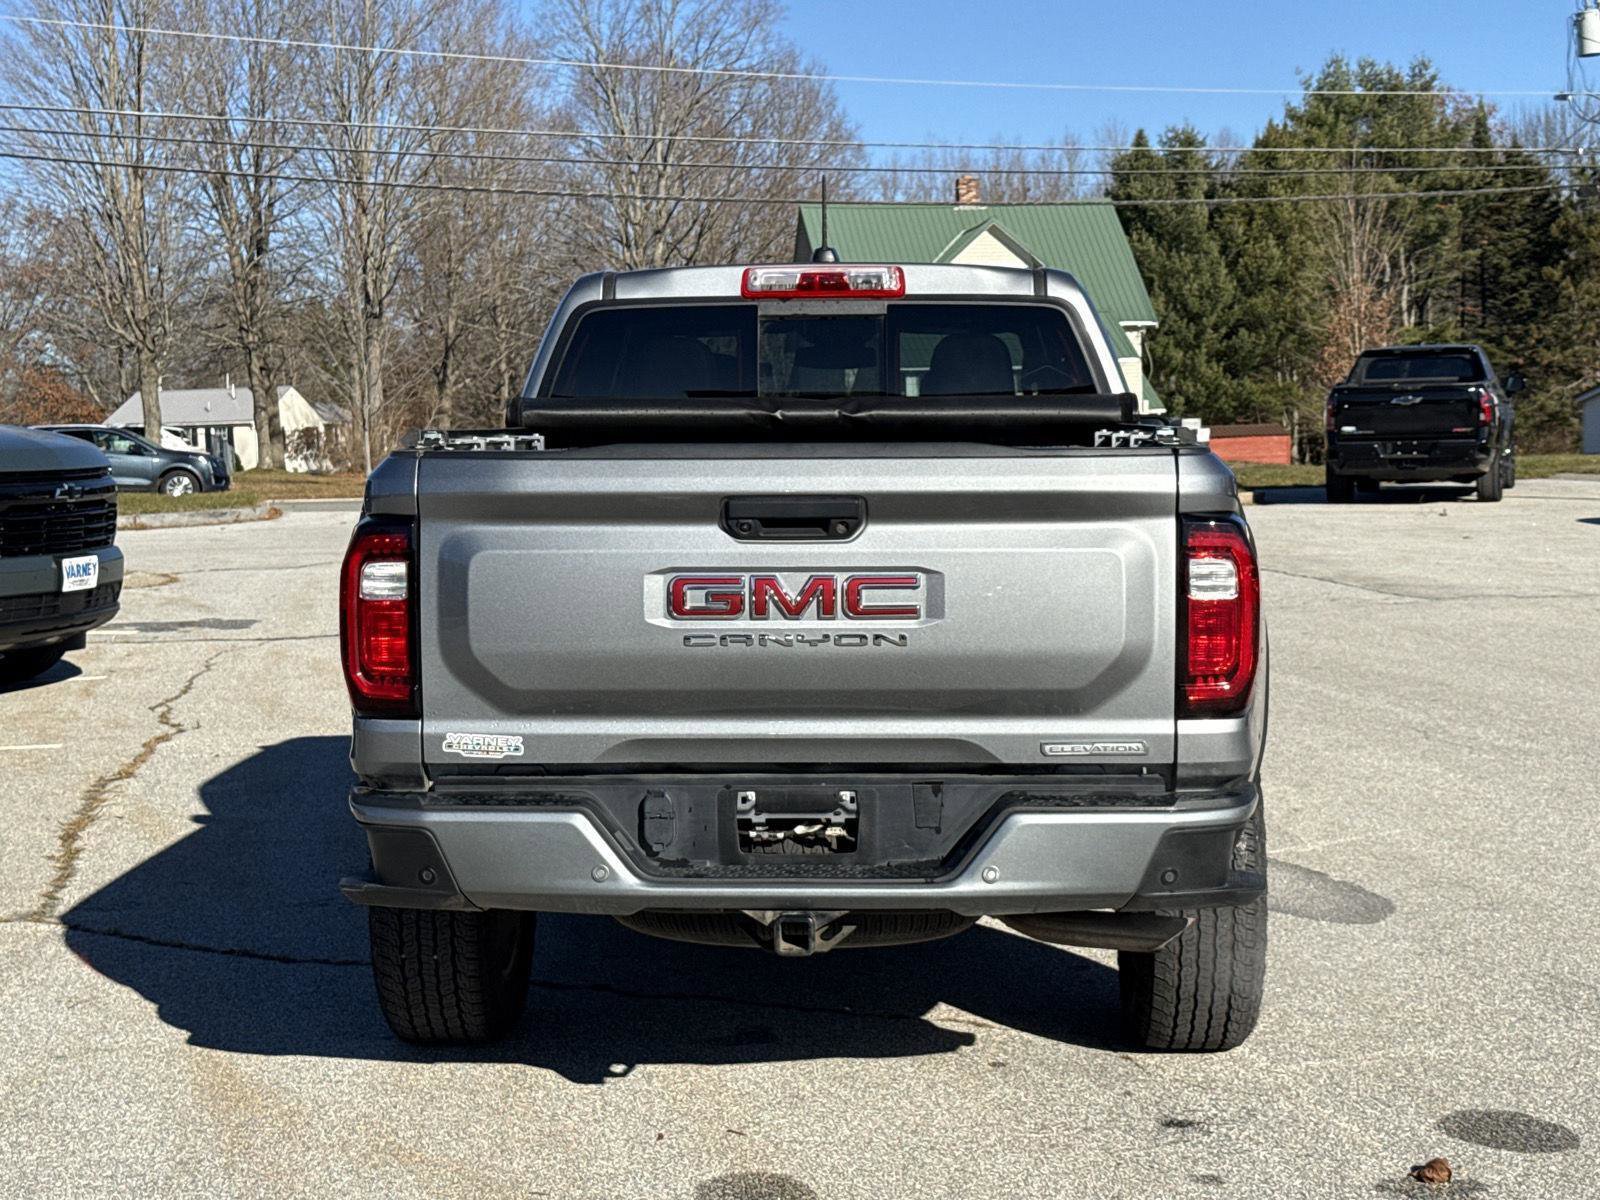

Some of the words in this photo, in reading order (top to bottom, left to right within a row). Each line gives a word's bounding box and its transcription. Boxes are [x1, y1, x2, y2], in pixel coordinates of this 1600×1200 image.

[65, 562, 97, 578] VARNEY
[667, 575, 921, 620] GMC
[683, 633, 908, 647] CANYON
[447, 734, 522, 746] VARNEY
[1048, 744, 1141, 754] ELEVATION
